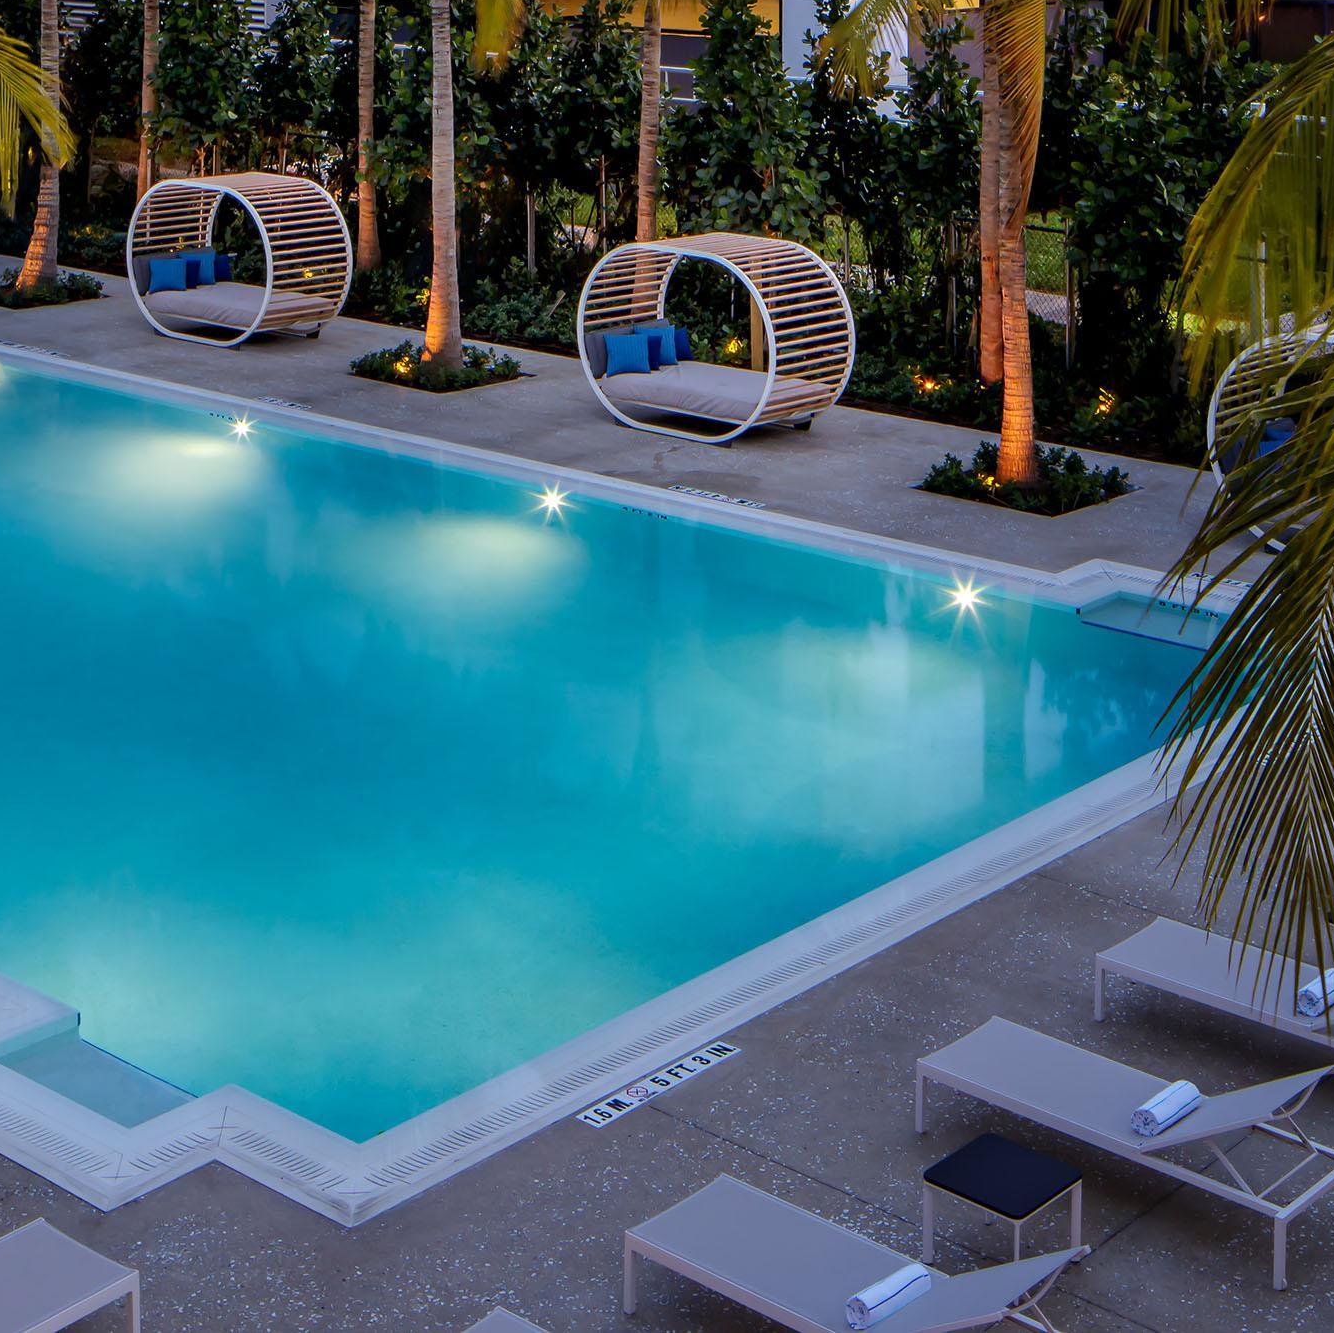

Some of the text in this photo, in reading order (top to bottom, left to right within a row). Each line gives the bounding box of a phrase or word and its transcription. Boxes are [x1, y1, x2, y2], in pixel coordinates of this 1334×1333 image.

[583, 1044, 737, 1125] 1.6 M. 5 FT. 3 IN.
